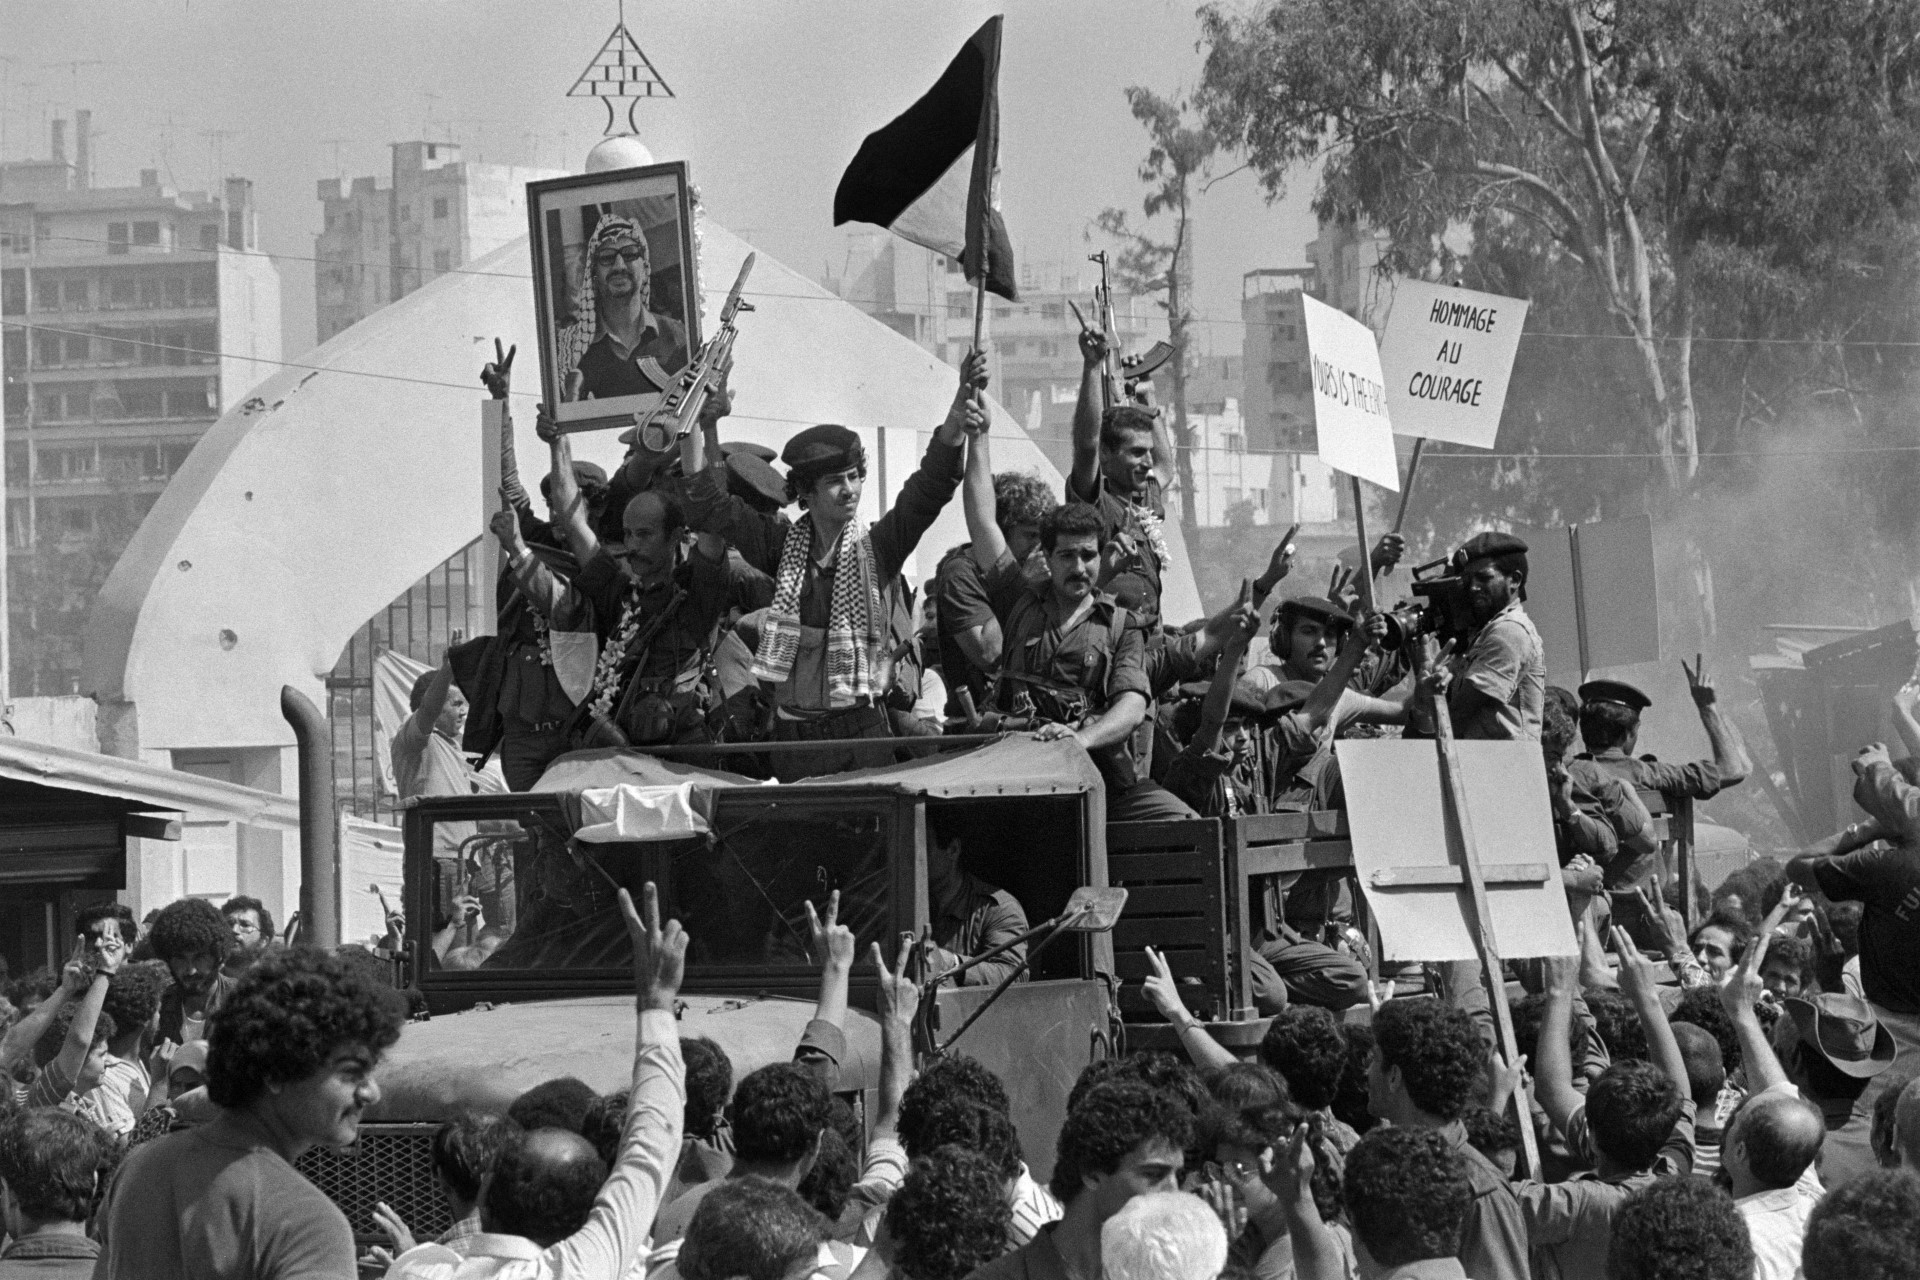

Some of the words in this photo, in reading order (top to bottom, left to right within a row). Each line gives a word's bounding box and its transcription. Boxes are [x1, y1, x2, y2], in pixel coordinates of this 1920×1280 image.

[1429, 298, 1497, 333] HOMMAGE
[1437, 340, 1462, 364] AU
[1310, 351, 1337, 399] YOURS
[1338, 367, 1349, 407] IS
[1349, 372, 1369, 413] THE
[1408, 371, 1483, 406] COURAGE
